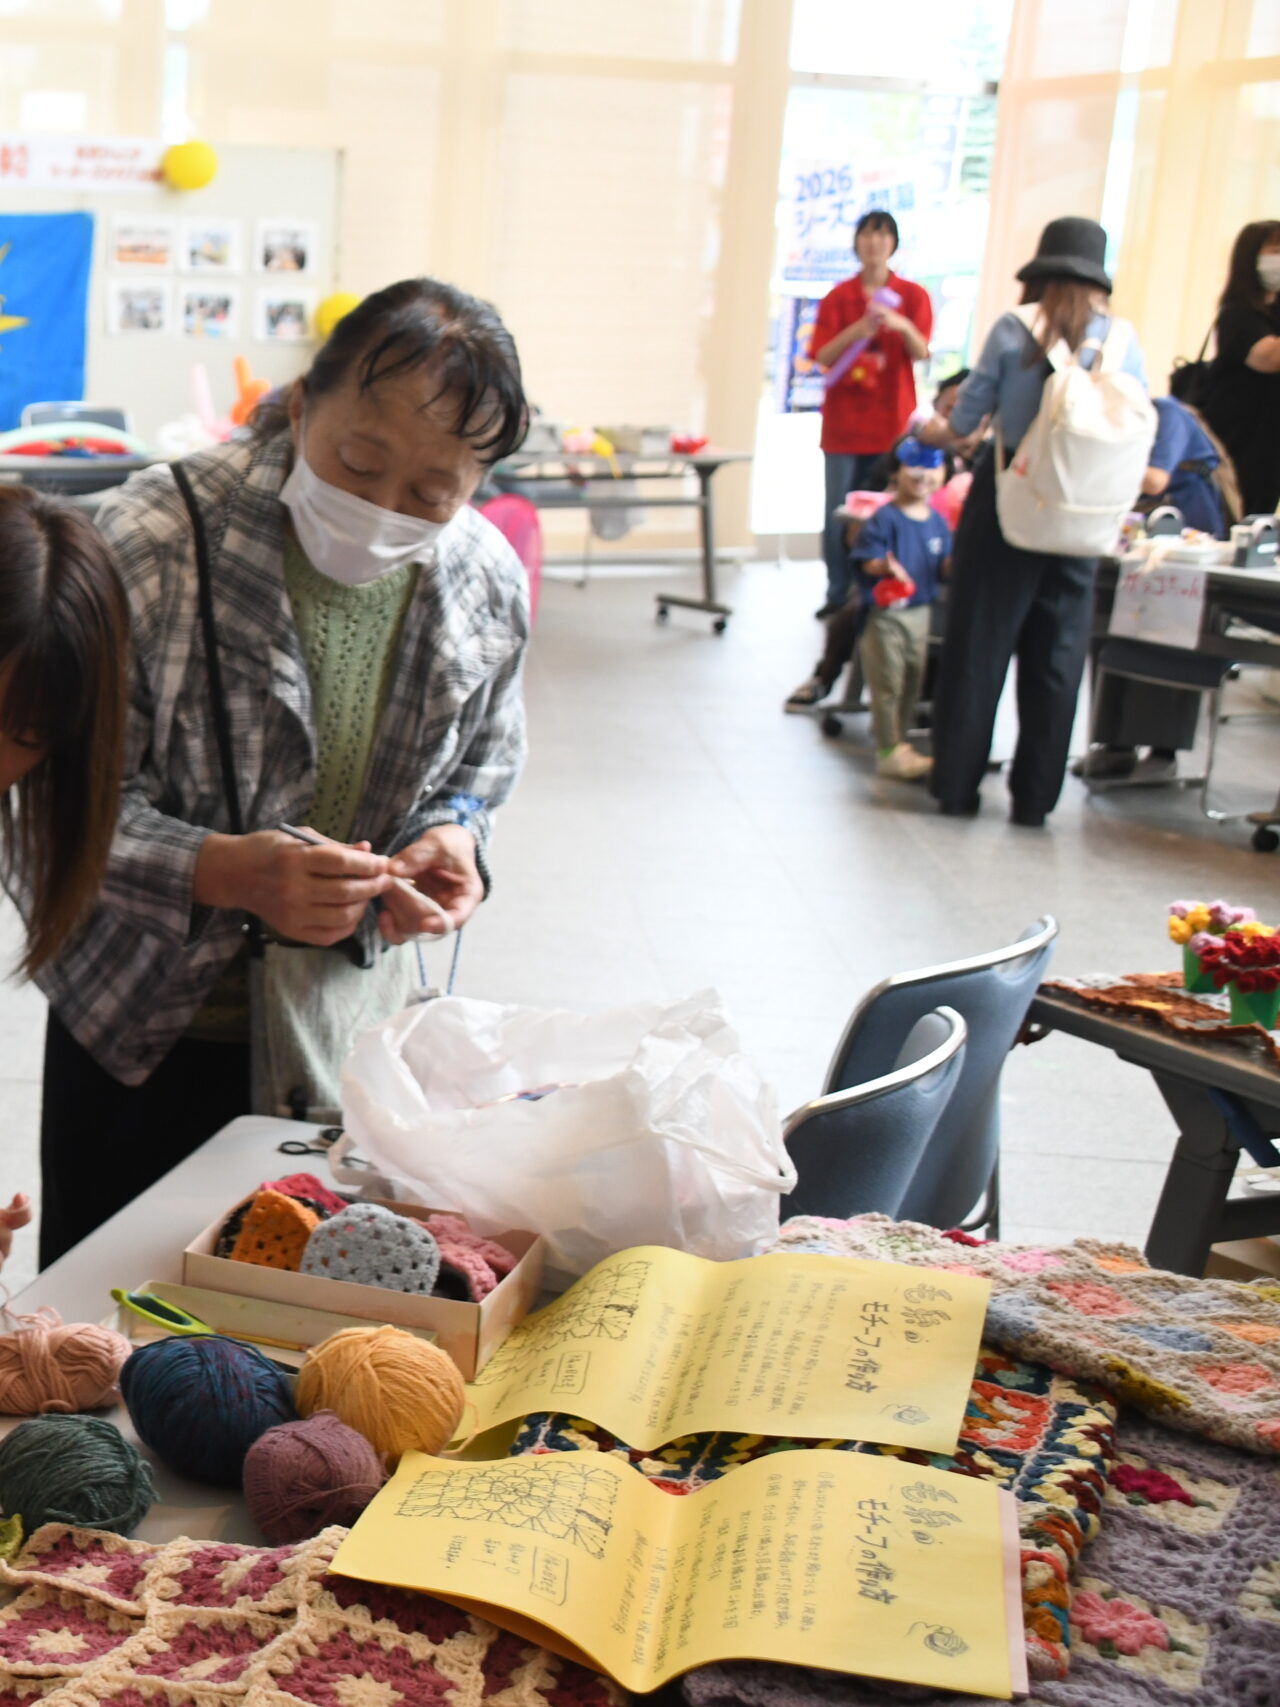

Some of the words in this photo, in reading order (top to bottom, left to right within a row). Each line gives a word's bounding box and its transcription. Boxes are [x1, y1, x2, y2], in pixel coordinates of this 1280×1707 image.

[843, 1300, 889, 1396] モチーフの作り方
[854, 1497, 898, 1605] モチーフの作り方
[900, 1480, 963, 1545] 毛糸の
